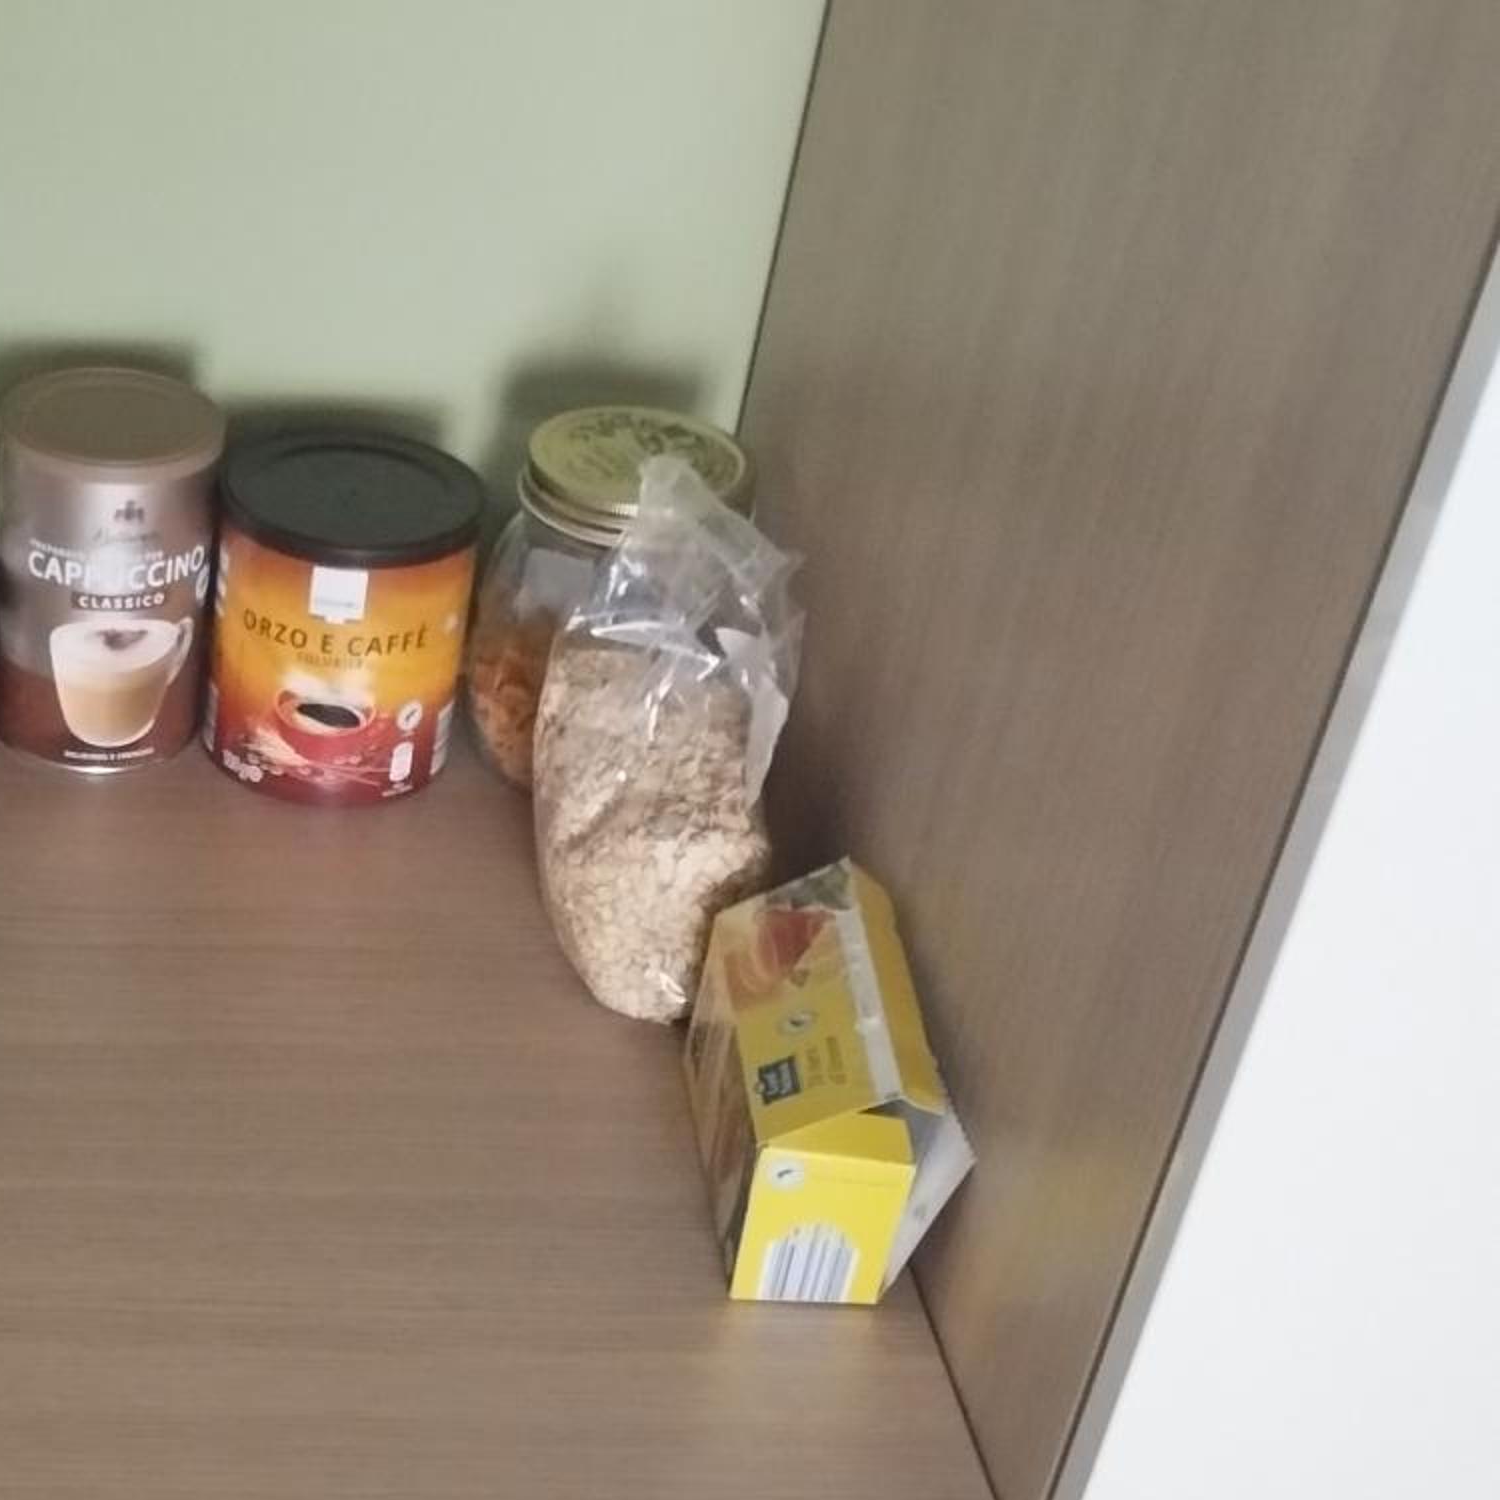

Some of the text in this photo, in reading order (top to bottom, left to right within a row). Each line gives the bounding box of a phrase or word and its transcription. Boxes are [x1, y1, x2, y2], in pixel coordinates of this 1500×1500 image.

[77, 592, 166, 610] CLASSICO
[242, 607, 308, 650] ORZO
[320, 634, 335, 654] E
